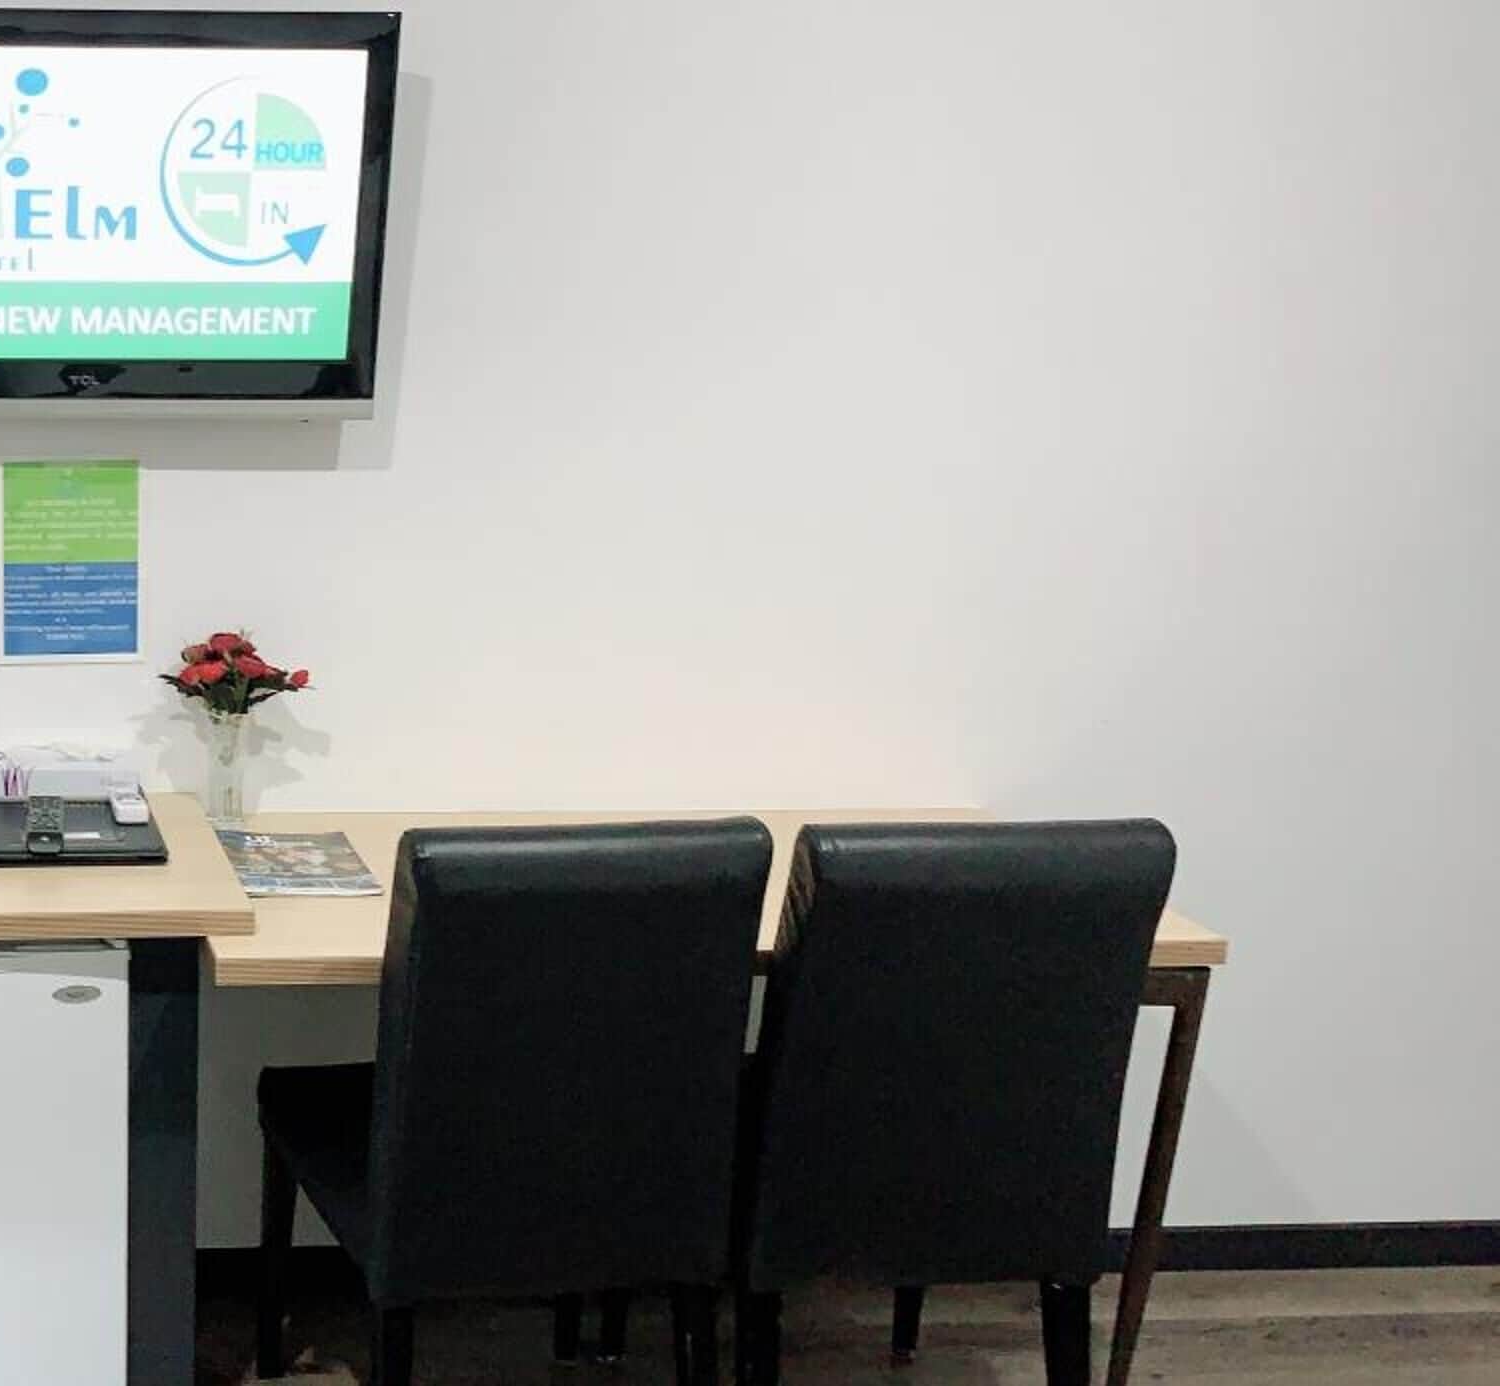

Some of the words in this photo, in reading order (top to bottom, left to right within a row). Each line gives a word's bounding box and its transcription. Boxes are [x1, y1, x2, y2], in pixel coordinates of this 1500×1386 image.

[189, 118, 248, 160] 24
[255, 141, 324, 163] HOUR
[260, 201, 290, 225] IN
[70, 304, 318, 336] MANAGEMENT
[68, 375, 101, 386] TCL
